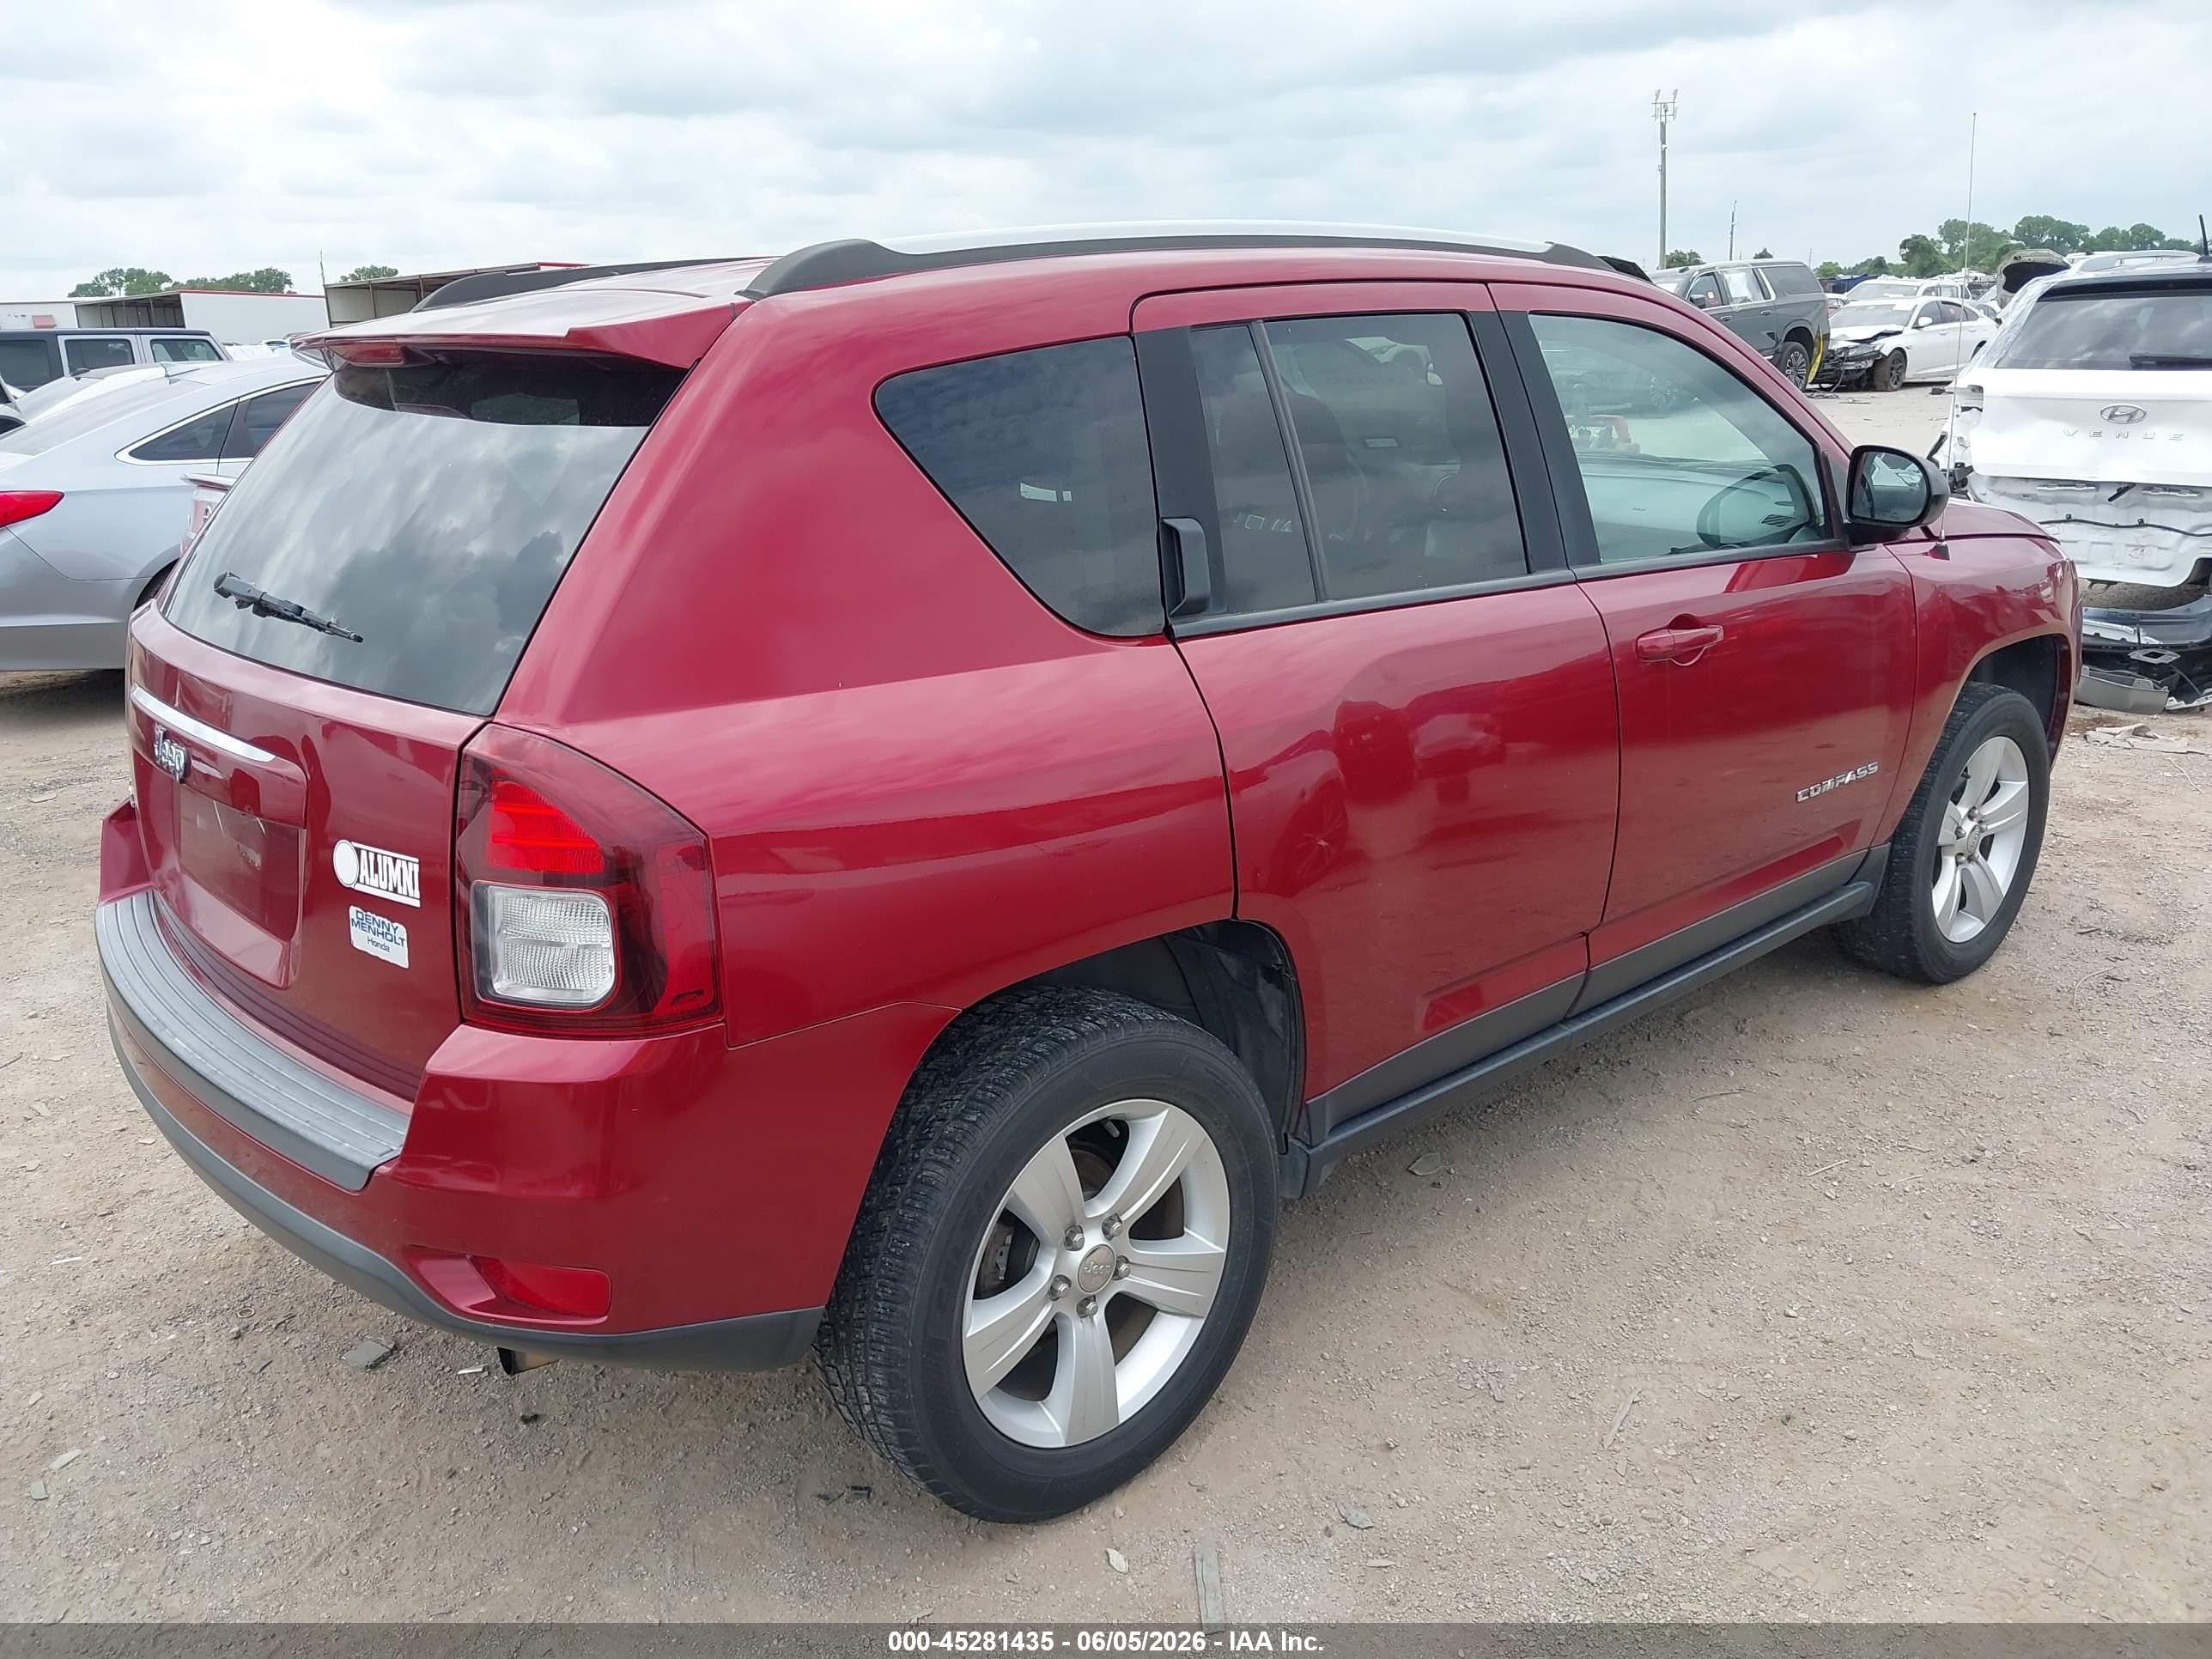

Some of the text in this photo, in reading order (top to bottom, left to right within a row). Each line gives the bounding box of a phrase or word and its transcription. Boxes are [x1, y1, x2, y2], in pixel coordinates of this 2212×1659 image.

[2062, 428, 2185, 441] VENUE
[154, 724, 188, 783] Jeep
[1796, 762, 1880, 803] COMPASS
[359, 849, 420, 899] ALUMNI
[351, 918, 406, 948] MENHOLT
[356, 908, 400, 935] DENNY
[367, 936, 391, 953] Honda
